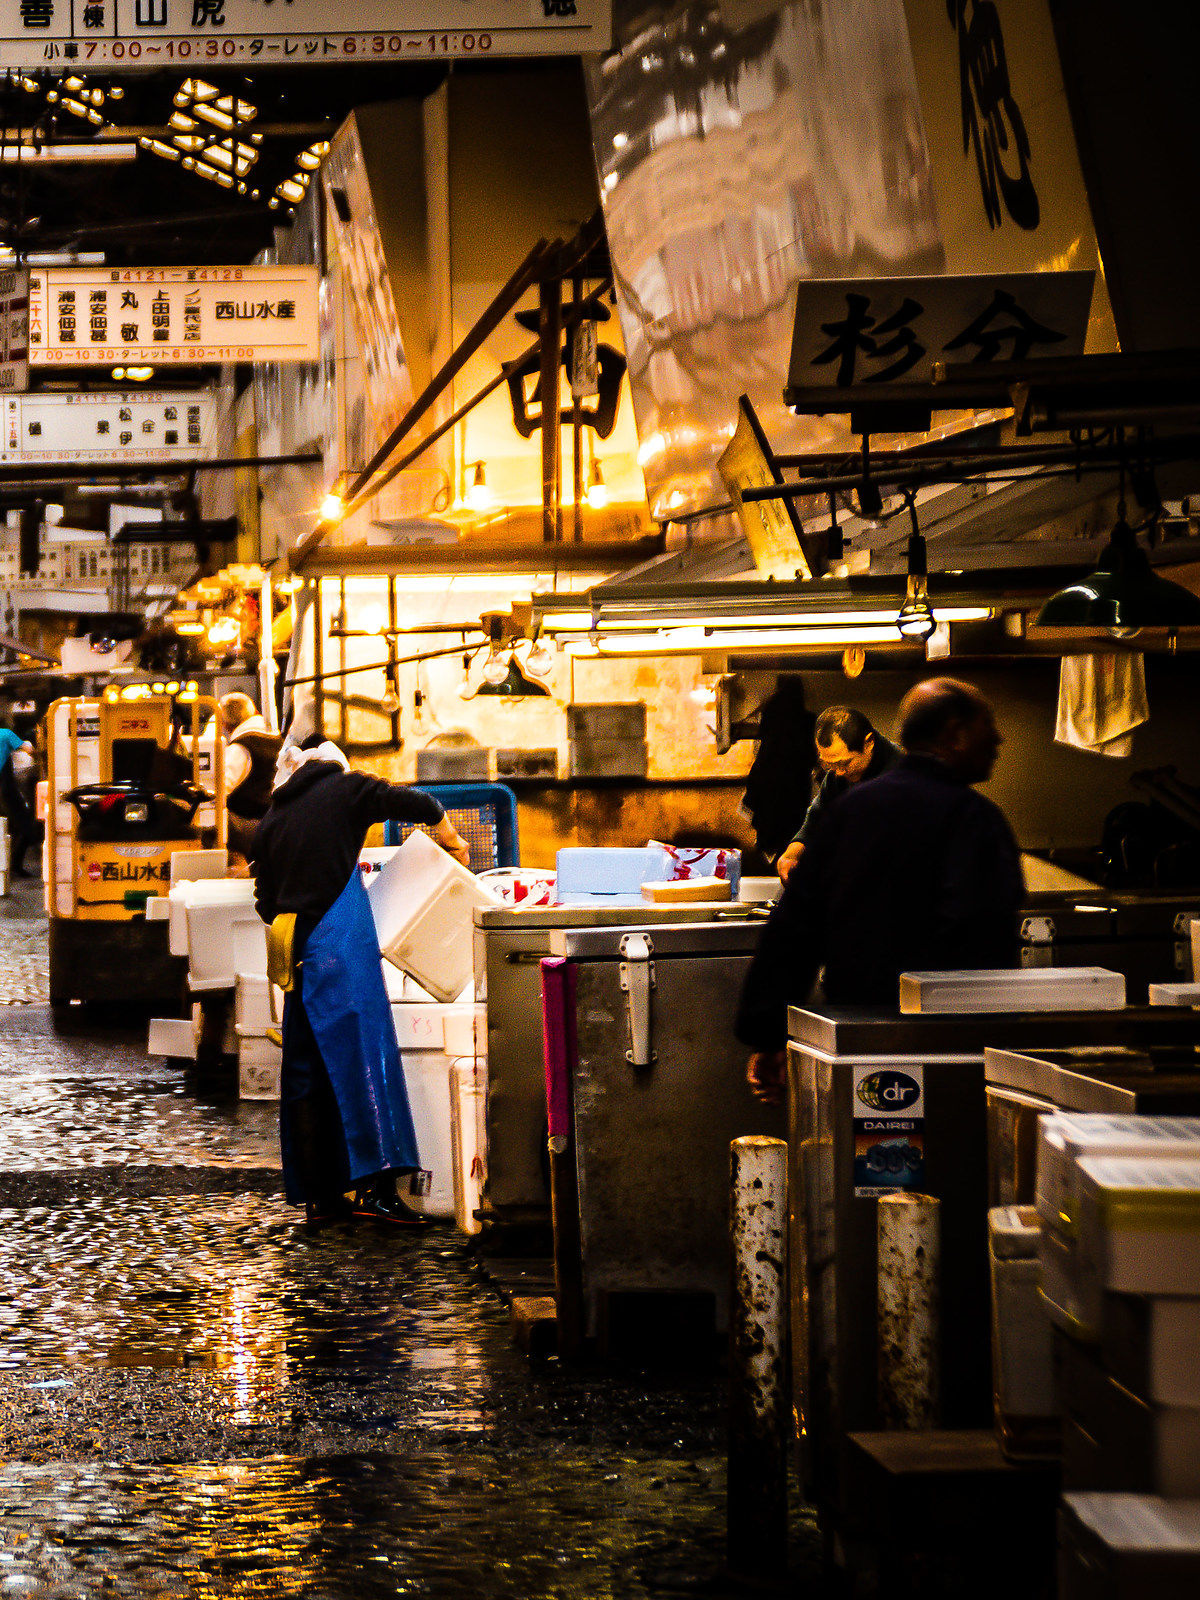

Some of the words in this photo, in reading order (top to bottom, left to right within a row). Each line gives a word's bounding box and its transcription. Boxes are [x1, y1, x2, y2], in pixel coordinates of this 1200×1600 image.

[215, 299, 296, 319] 西山水産
[863, 1120, 915, 1131] DAIREI
